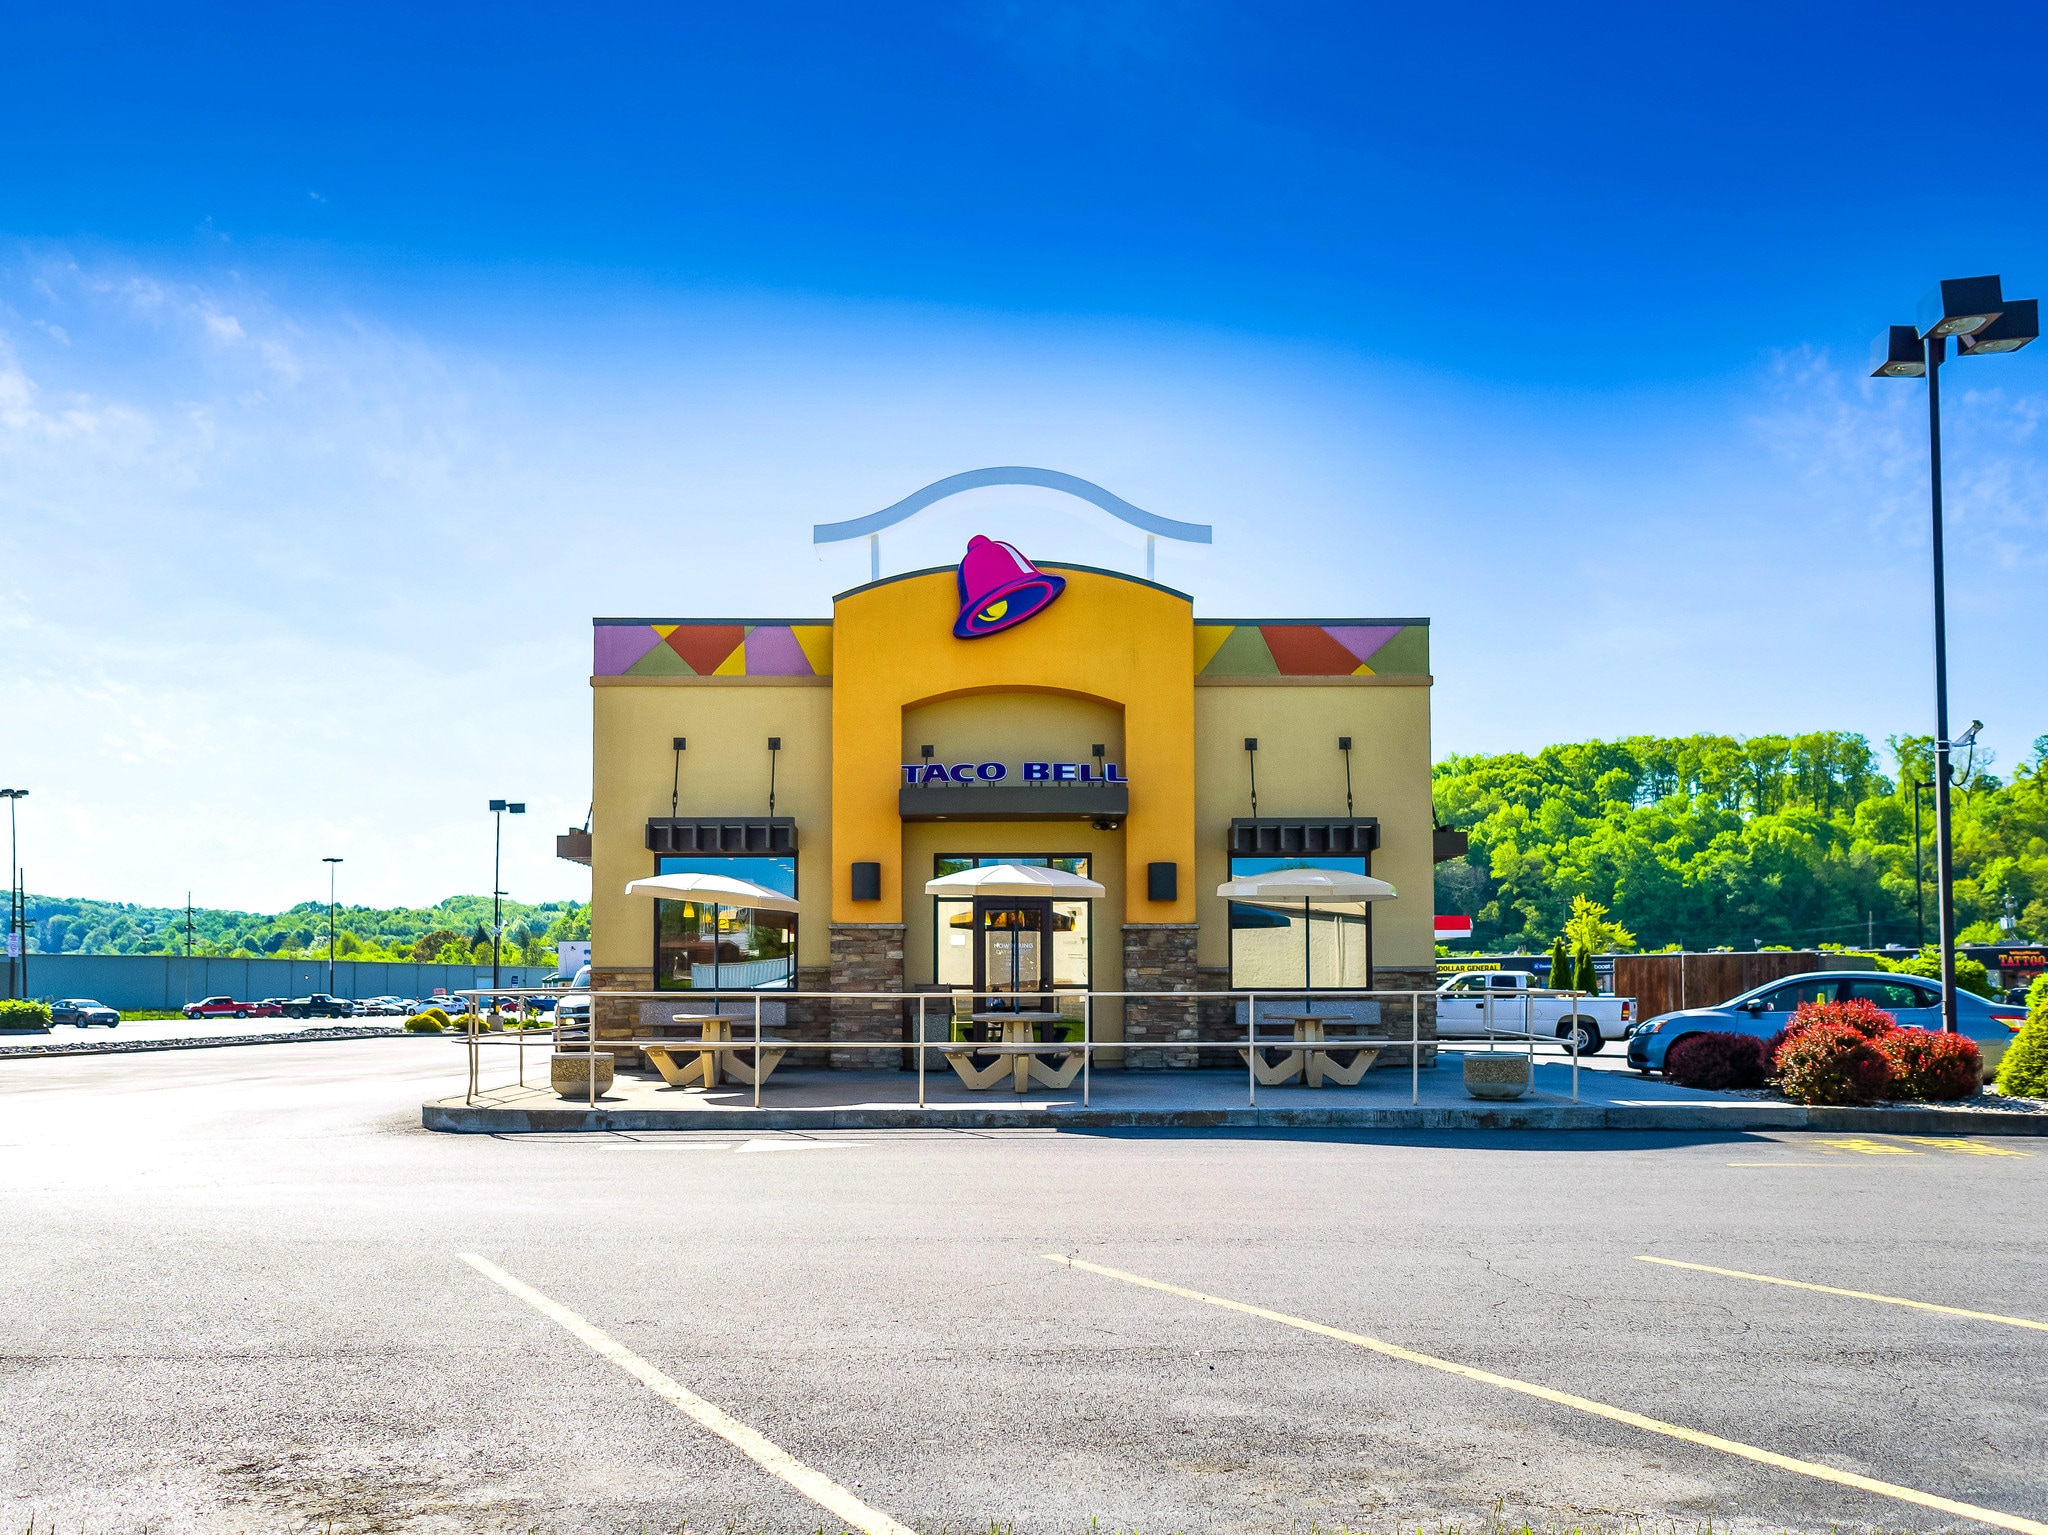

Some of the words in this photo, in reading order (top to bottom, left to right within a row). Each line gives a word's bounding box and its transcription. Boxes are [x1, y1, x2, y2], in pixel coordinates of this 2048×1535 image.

[901, 761, 1008, 783] TACO
[1022, 761, 1129, 783] BELL
[1999, 954, 2046, 966] TATTOO
